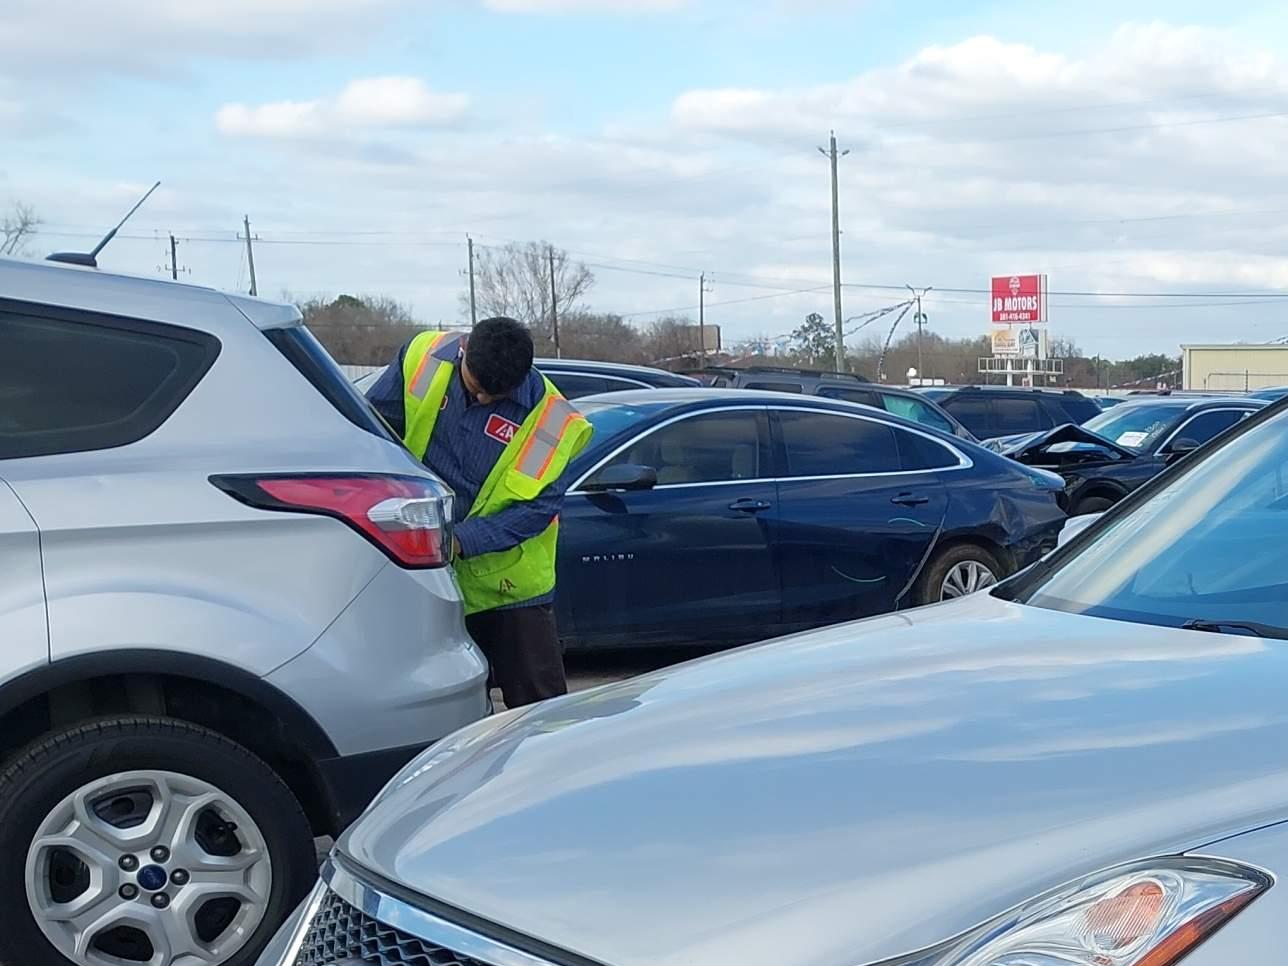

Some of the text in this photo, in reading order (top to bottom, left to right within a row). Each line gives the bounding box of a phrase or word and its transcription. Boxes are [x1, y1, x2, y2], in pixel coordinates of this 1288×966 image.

[993, 295, 1037, 312] JB MOTORS
[582, 553, 634, 562] MALIBU
